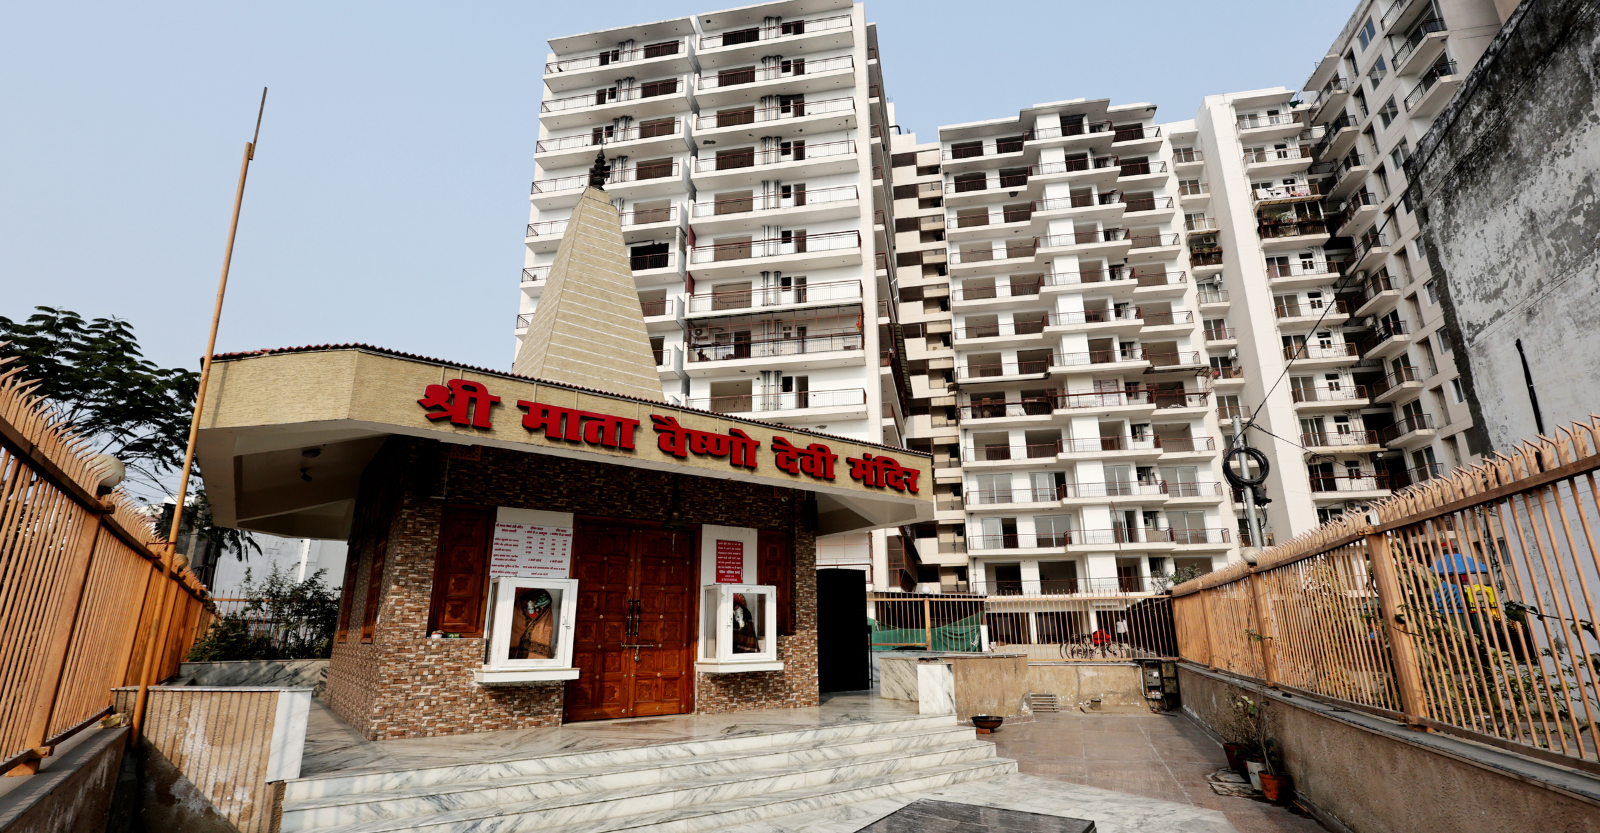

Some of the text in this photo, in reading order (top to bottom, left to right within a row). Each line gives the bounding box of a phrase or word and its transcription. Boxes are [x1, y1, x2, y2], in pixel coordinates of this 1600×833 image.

[417, 378, 921, 493] श्री माता वैष्णो देवी मंदिर
